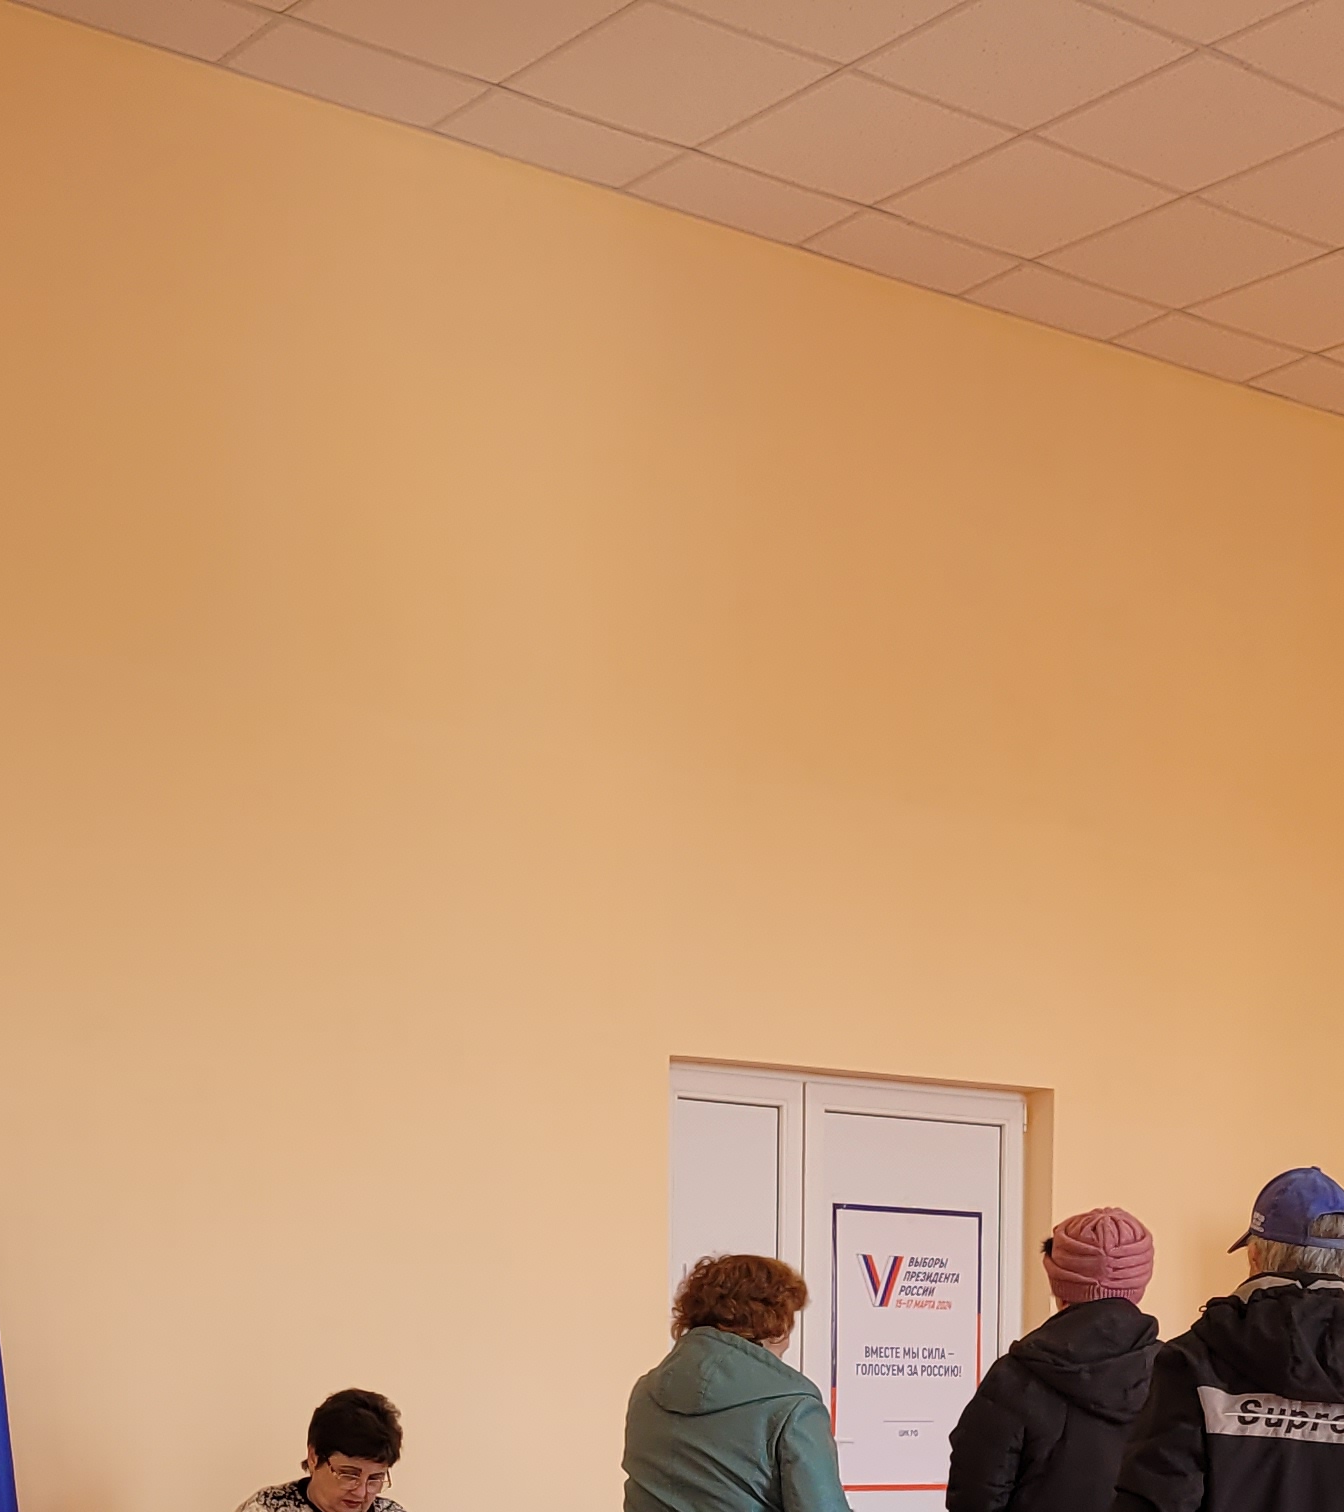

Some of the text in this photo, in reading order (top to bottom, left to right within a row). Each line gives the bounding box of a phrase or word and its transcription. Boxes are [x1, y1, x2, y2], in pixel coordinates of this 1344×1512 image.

[908, 1256, 948, 1268] ВЫБОРЫ
[903, 1271, 960, 1284] ПРЕЗИДЕНТА
[898, 1285, 936, 1297] РОССИИ
[864, 1346, 900, 1359] ВМЕСТЕ
[903, 1347, 919, 1359] МЫ
[922, 1347, 946, 1360] СИЛА
[855, 1363, 962, 1378] ГОЛОСУЕМ ЗА РОССИЮ!
